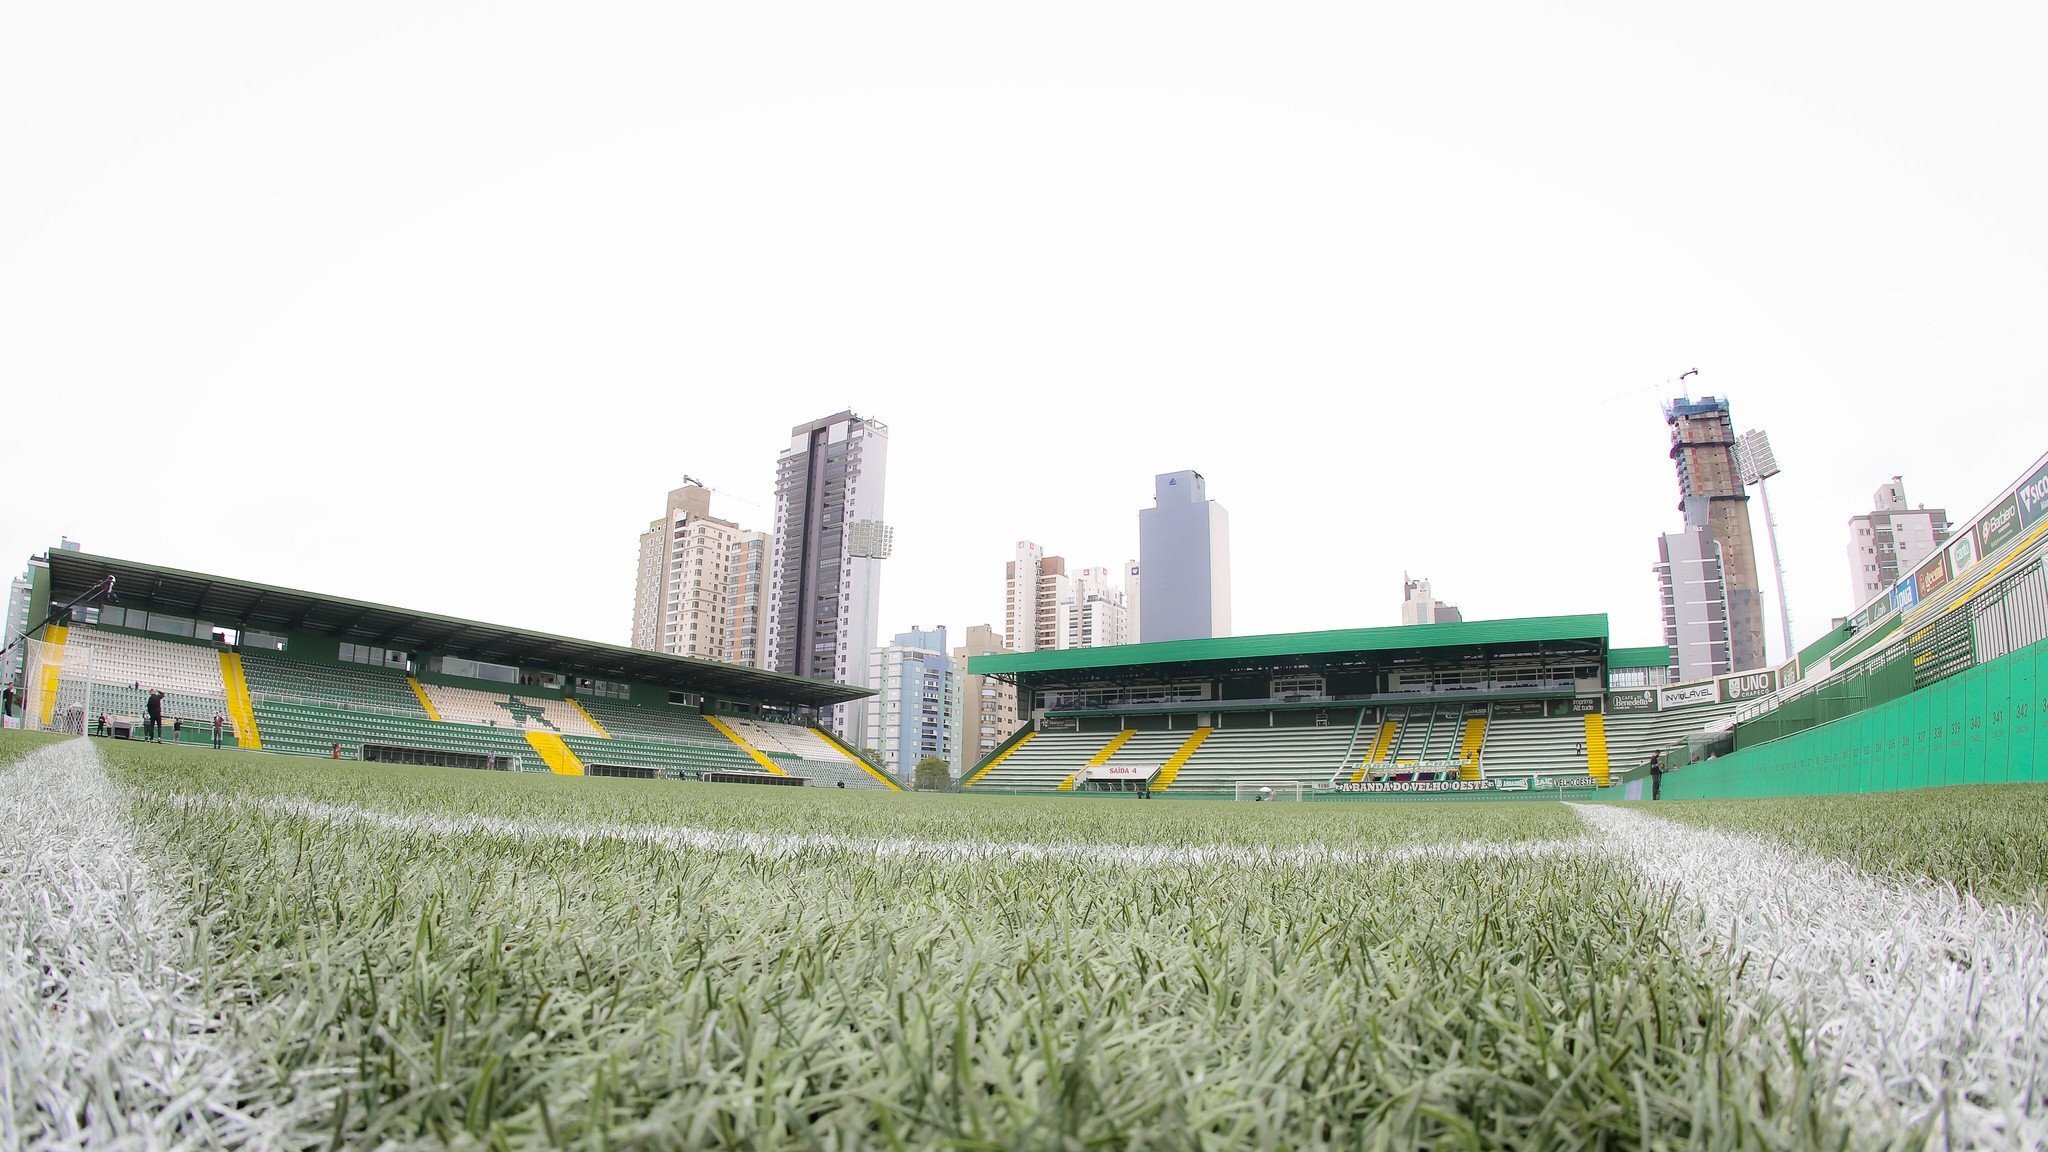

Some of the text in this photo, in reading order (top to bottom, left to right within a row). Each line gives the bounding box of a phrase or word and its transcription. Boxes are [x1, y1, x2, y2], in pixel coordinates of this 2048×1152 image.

[1740, 673, 1769, 691] UNO
[1665, 688, 1713, 701] INVIOLÁVEL
[1992, 710, 2003, 725] 341
[2016, 703, 2028, 719] 342
[1109, 766, 1129, 774] SAÍDA
[1342, 782, 1351, 792] A
[1351, 782, 1391, 792] BANDA
[1393, 782, 1411, 792] DO
[1411, 781, 1449, 791] VELHO
[1452, 780, 1488, 791] OESTE
[1554, 777, 1594, 787] VELHO OESTE
